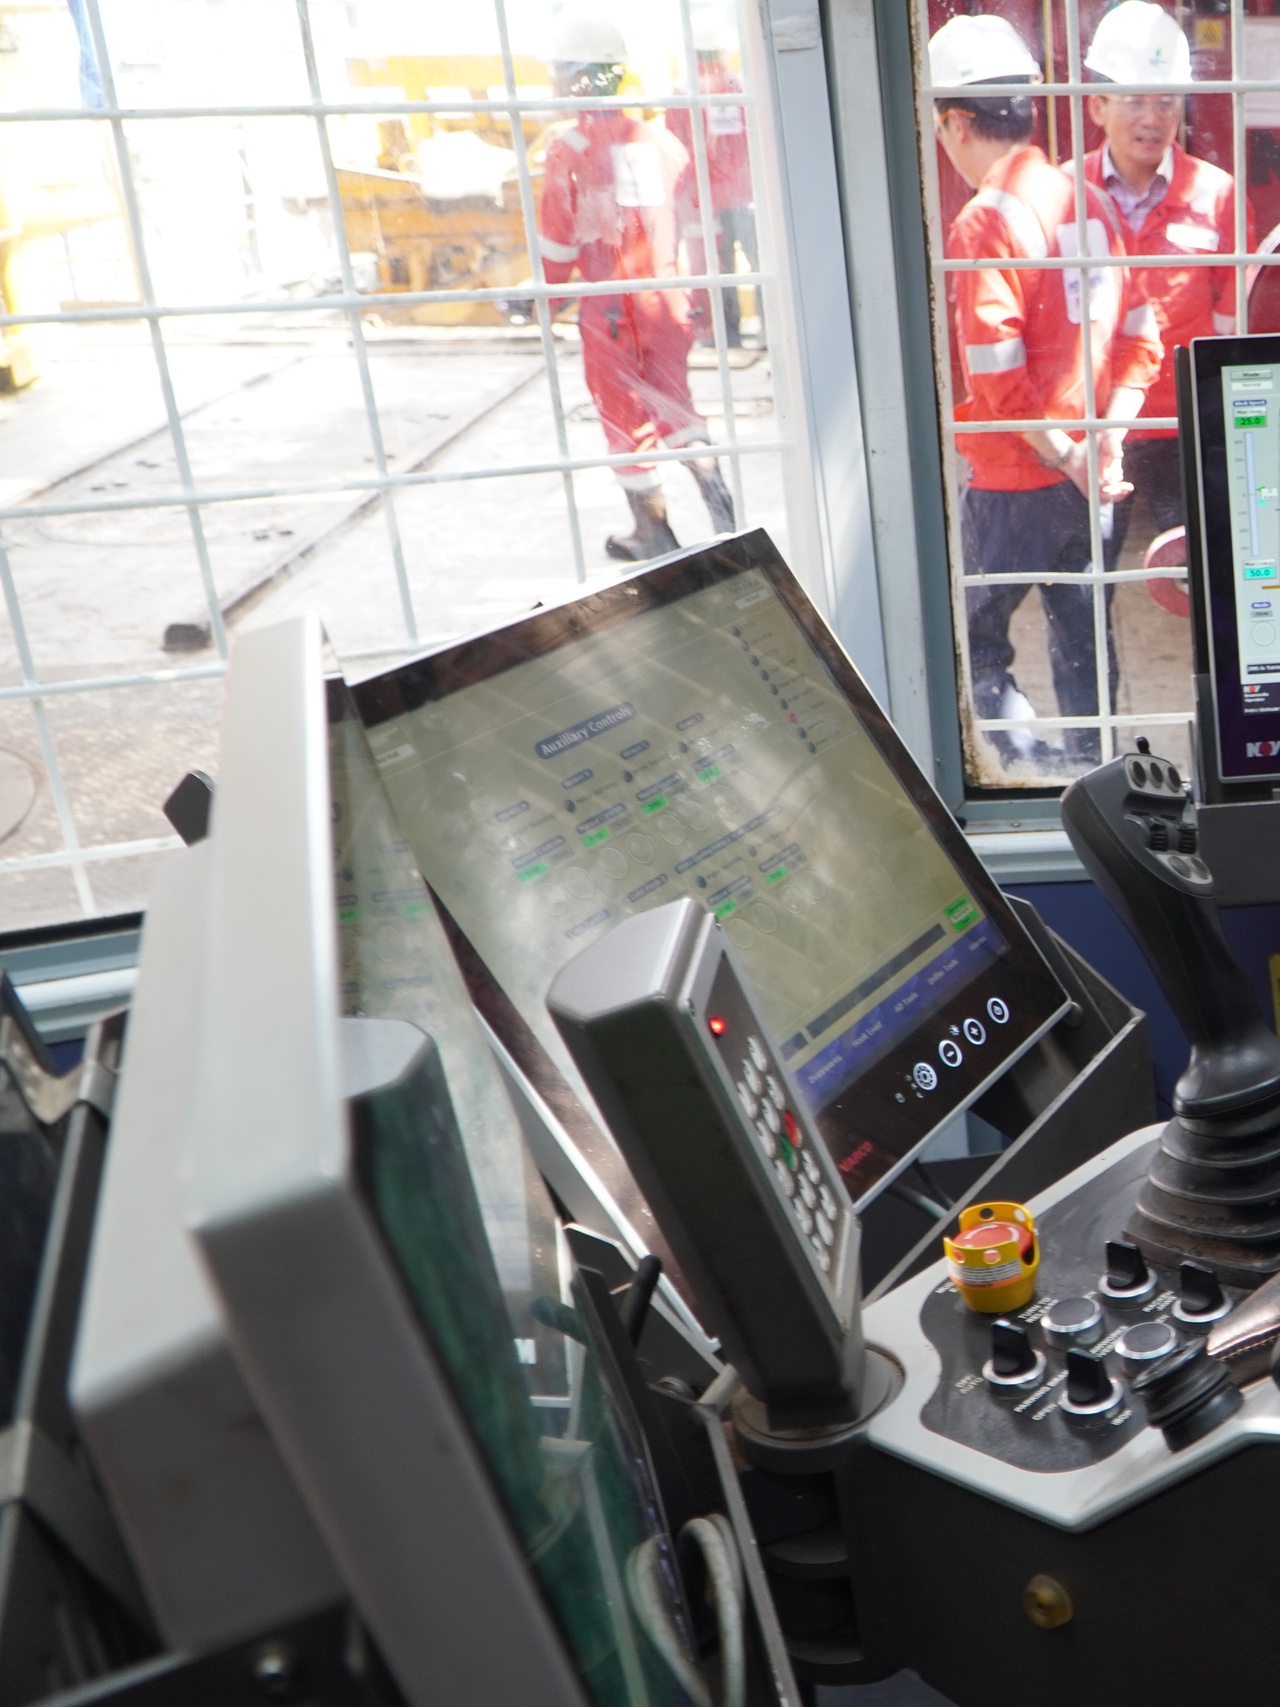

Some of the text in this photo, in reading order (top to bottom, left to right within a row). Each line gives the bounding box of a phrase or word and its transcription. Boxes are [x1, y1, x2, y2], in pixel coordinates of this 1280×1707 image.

[1240, 417, 1261, 426] 25.0
[1250, 569, 1270, 578] 50.0
[541, 704, 633, 756] Auxiliary Controls
[839, 1141, 874, 1173] VARCO
[1013, 1369, 1069, 1414] PARKING BRAK
[1032, 1403, 1058, 1421] OPEN
